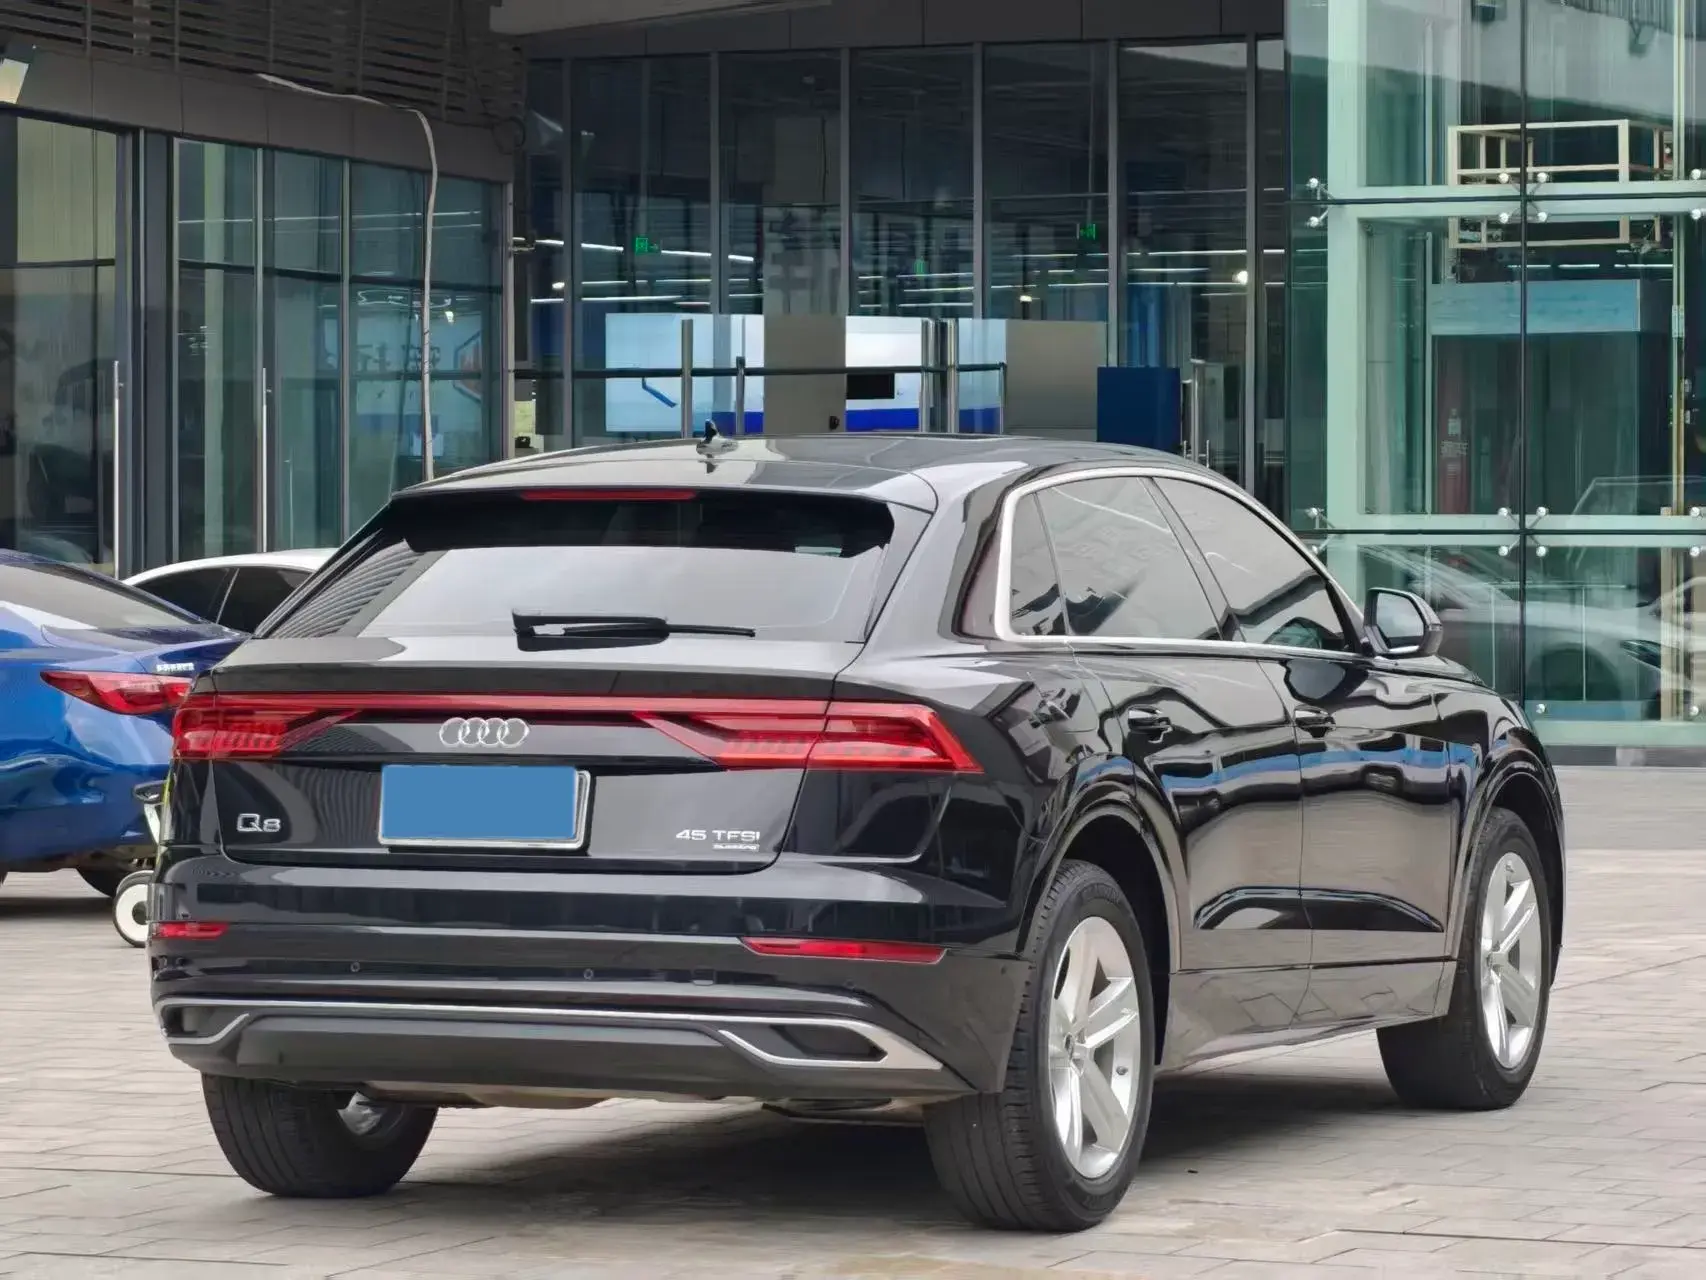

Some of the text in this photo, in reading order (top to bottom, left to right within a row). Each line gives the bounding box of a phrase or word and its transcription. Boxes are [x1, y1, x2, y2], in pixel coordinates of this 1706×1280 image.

[236, 813, 281, 832] Q8
[675, 829, 761, 842] 45 TFSI
